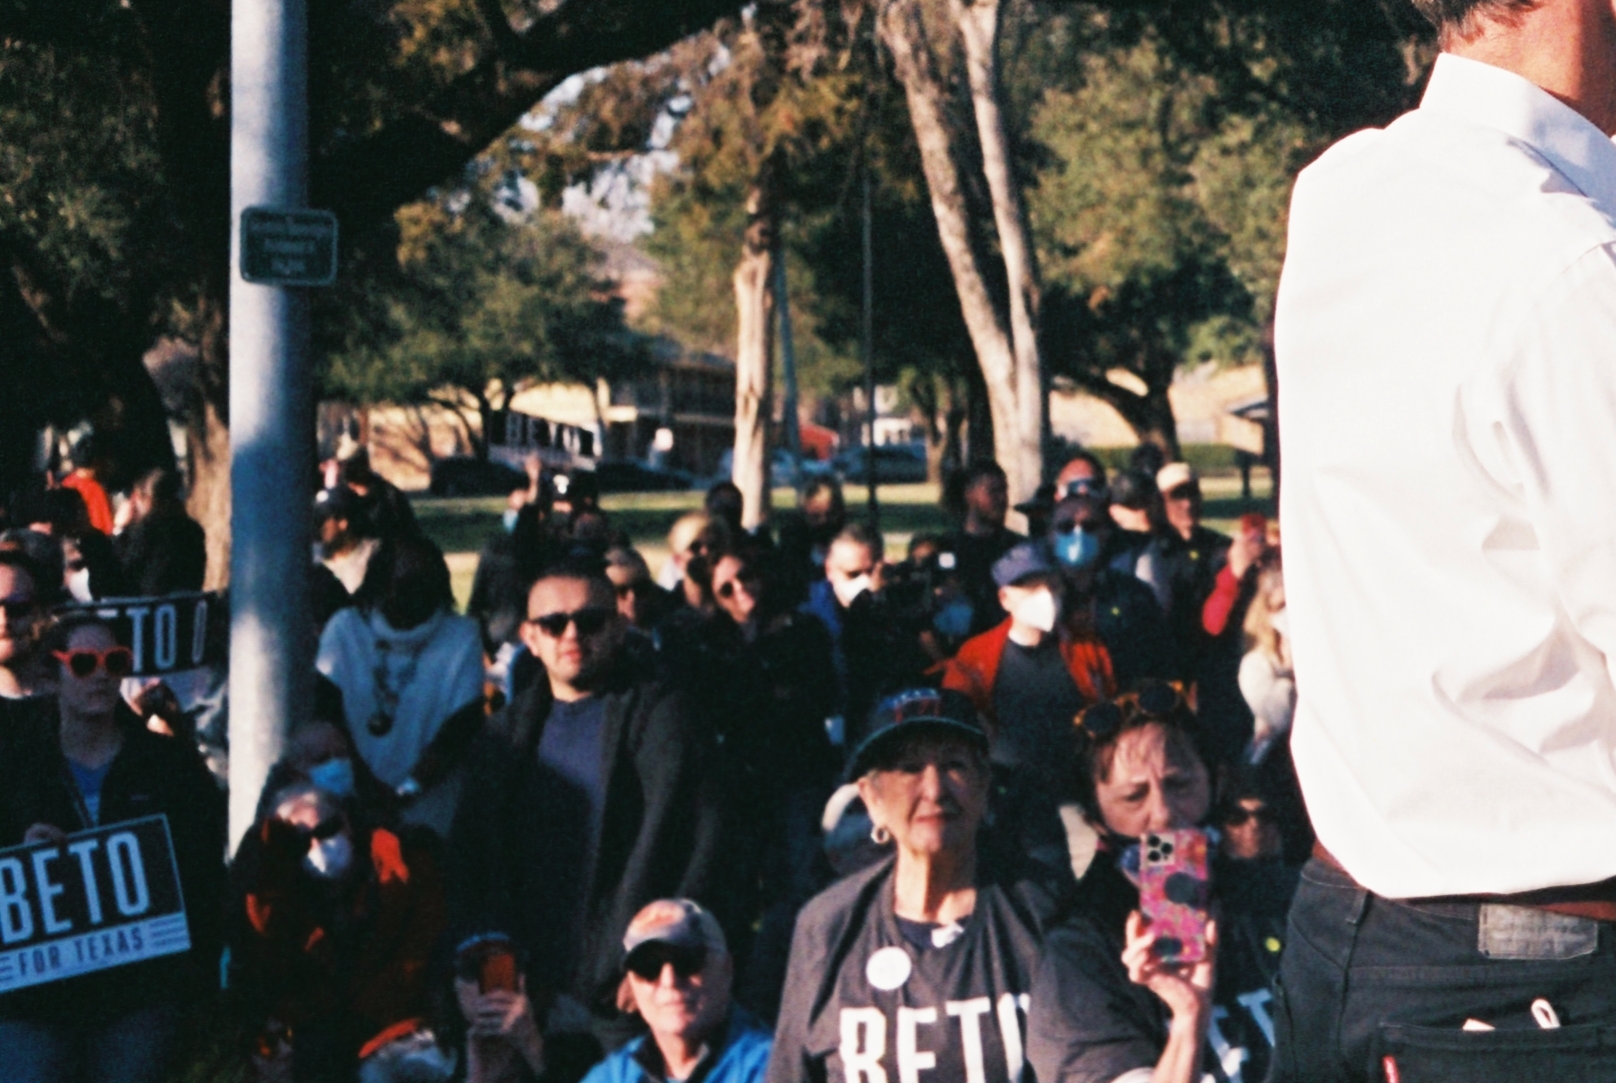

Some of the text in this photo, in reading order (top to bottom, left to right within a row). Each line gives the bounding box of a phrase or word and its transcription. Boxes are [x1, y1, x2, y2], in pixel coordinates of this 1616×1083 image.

[96, 603, 177, 673] TO
[0, 831, 150, 945] BETO
[18, 926, 144, 977] FOR TEXAS
